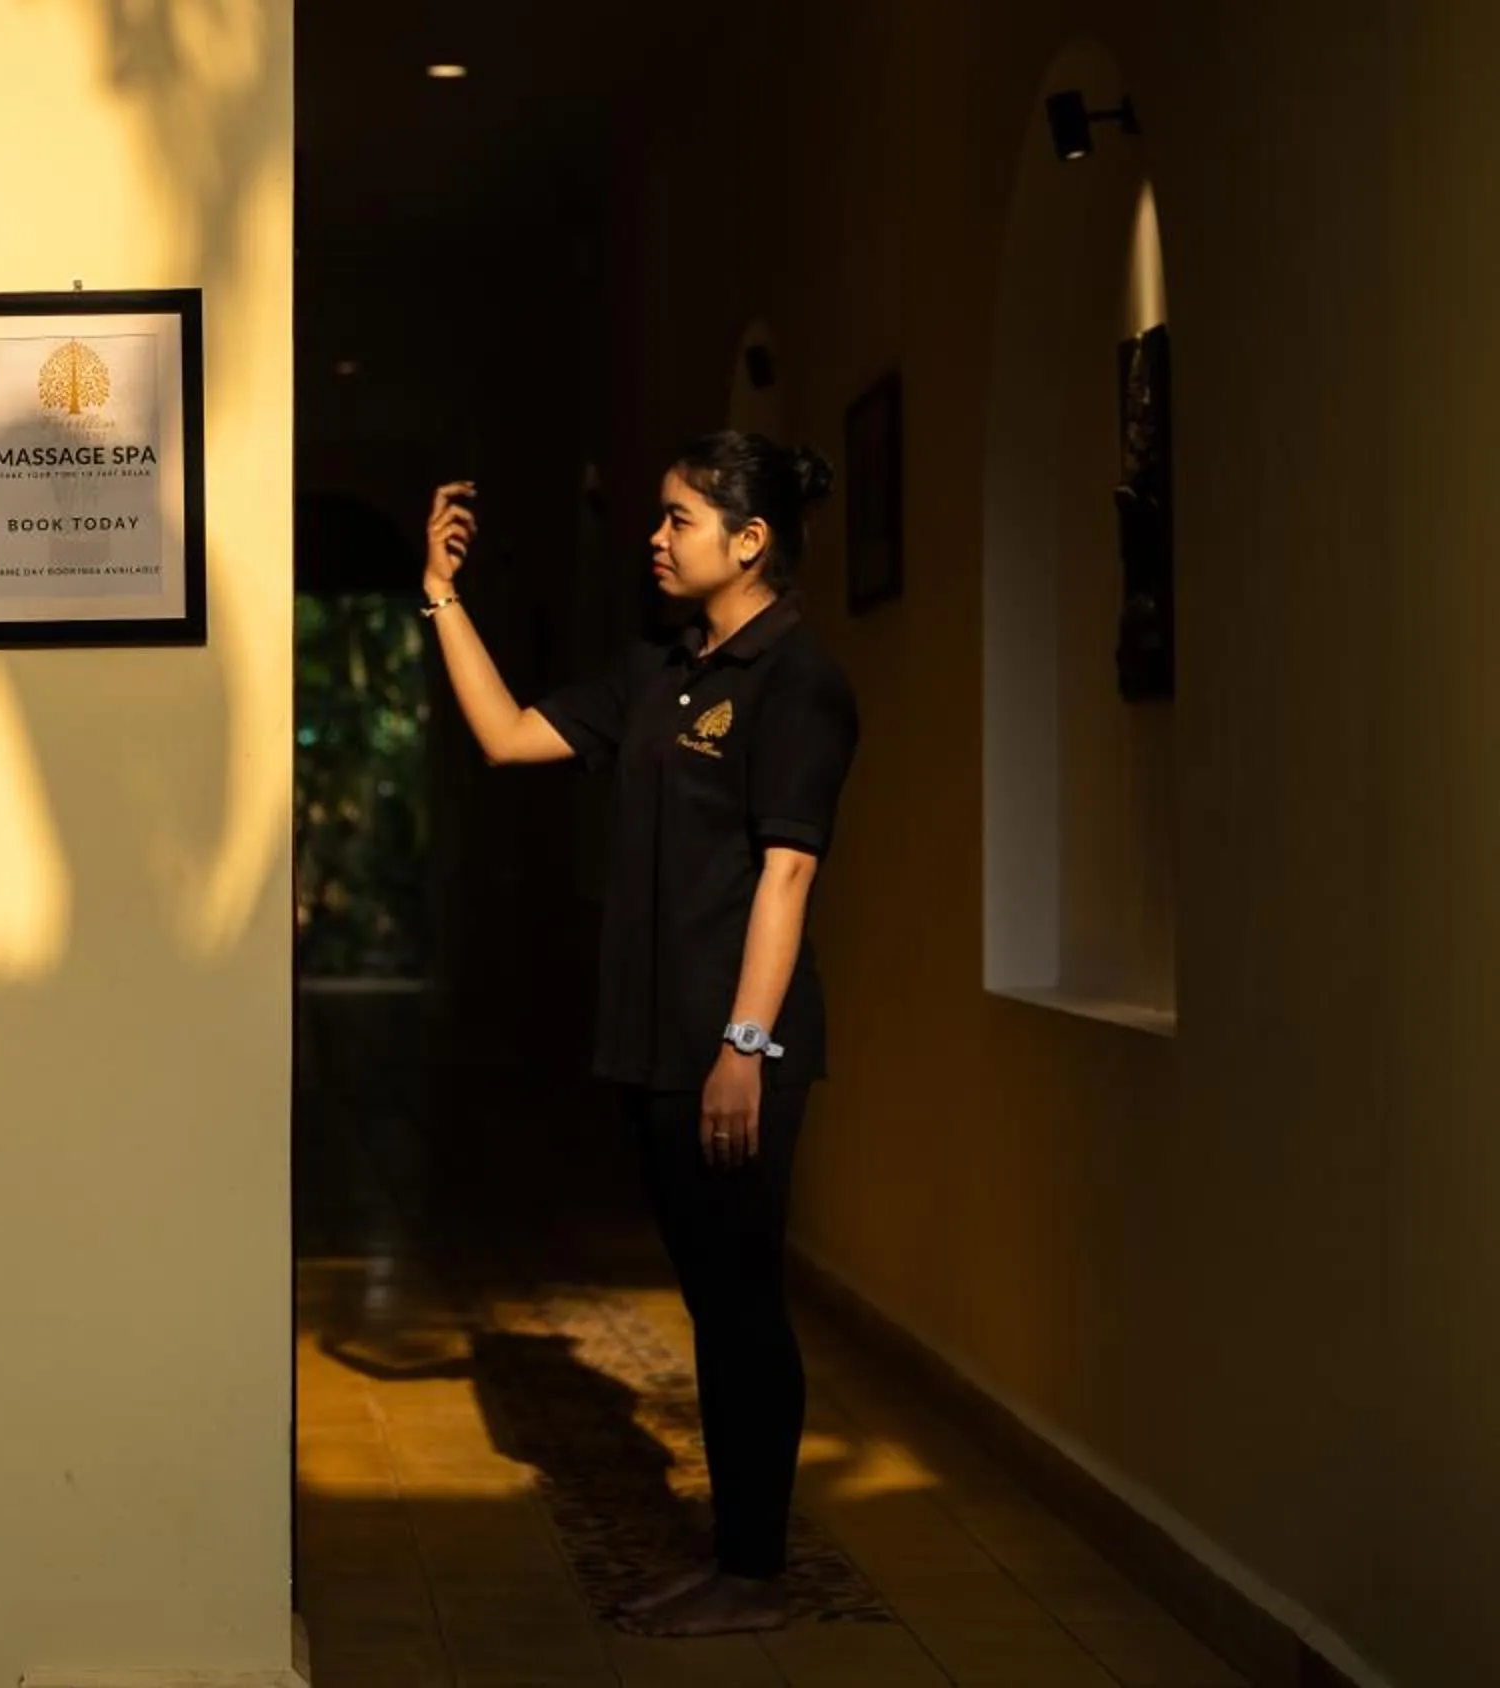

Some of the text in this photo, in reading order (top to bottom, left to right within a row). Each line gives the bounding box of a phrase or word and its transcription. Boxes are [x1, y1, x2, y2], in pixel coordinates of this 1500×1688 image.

[112, 445, 157, 464] SPA
[7, 516, 139, 532] BOOK TODAY
[24, 567, 45, 577] DAY
[48, 566, 101, 576] BOOKINGS
[104, 565, 161, 576] AVAILABLE
